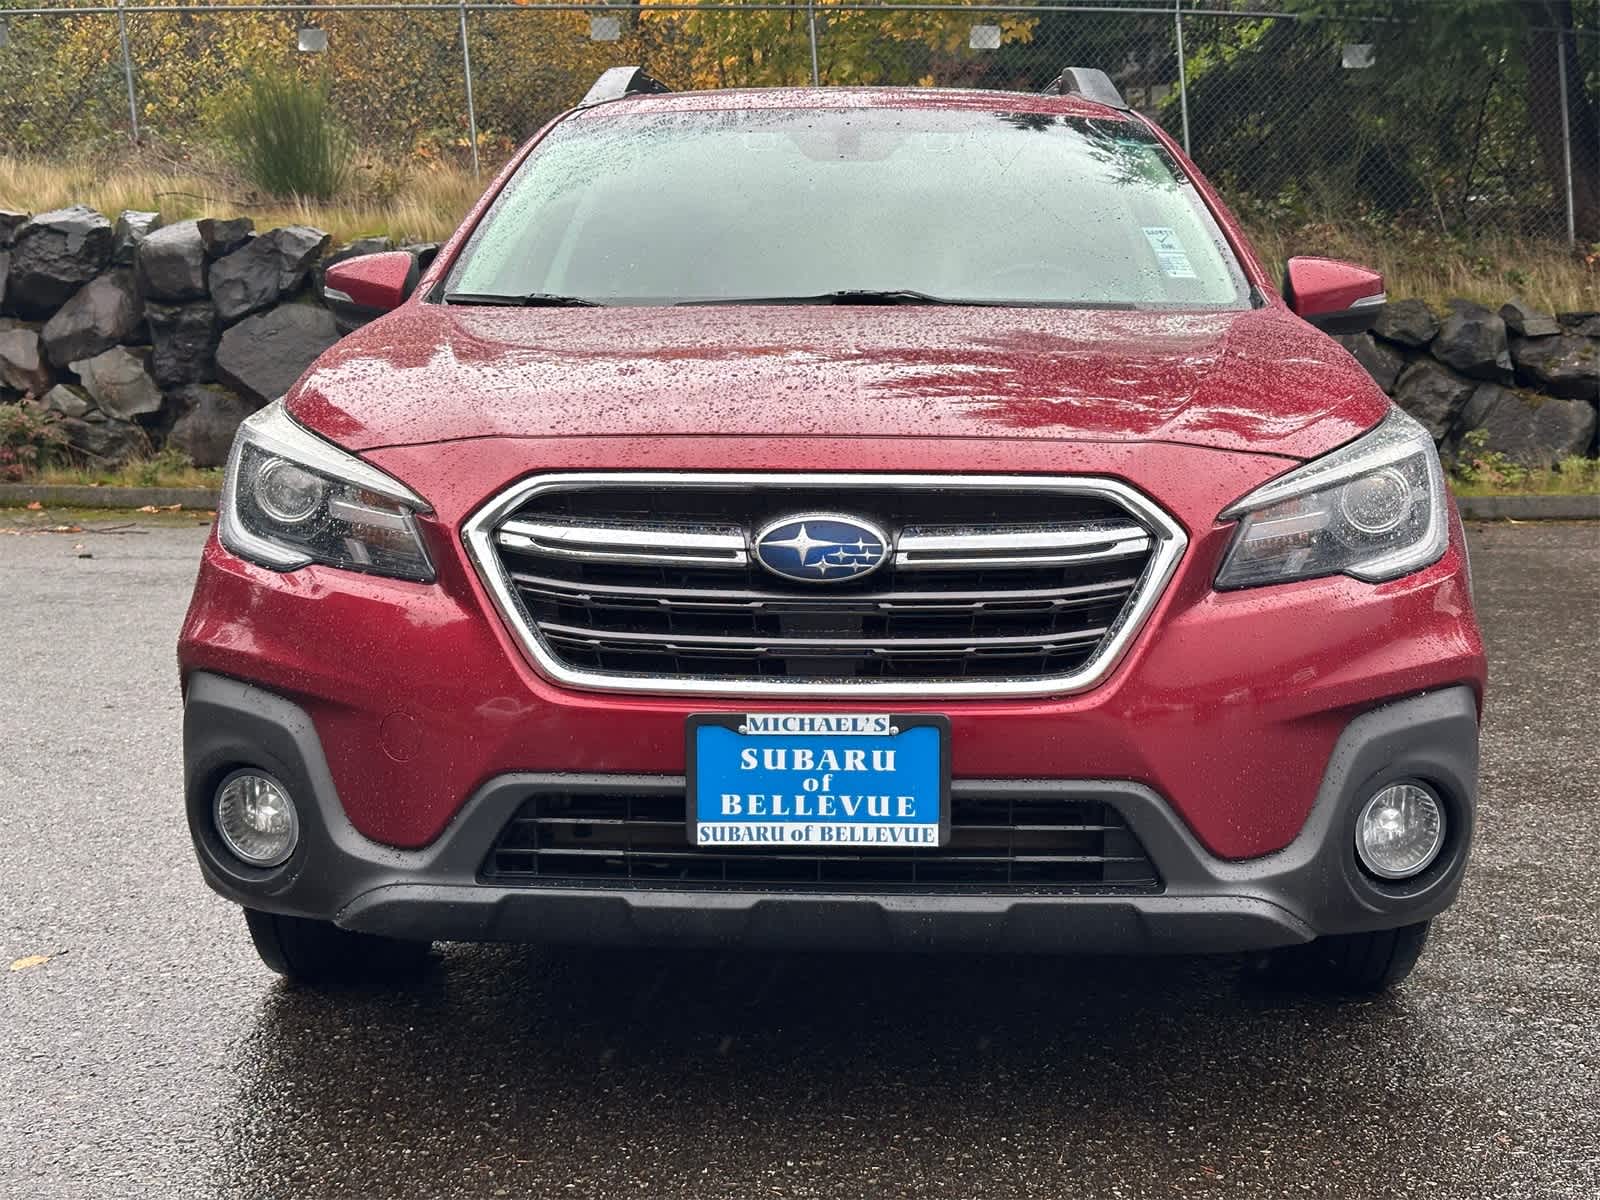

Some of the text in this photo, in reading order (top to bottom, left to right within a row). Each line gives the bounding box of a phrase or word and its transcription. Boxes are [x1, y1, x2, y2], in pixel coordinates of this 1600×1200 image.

[749, 717, 886, 732] MICHAEL'S
[740, 748, 897, 771] SUBARU
[802, 773, 833, 792] of
[720, 794, 916, 817] BELLEVUE
[700, 825, 934, 843] SUBARU of BELLEVUE
